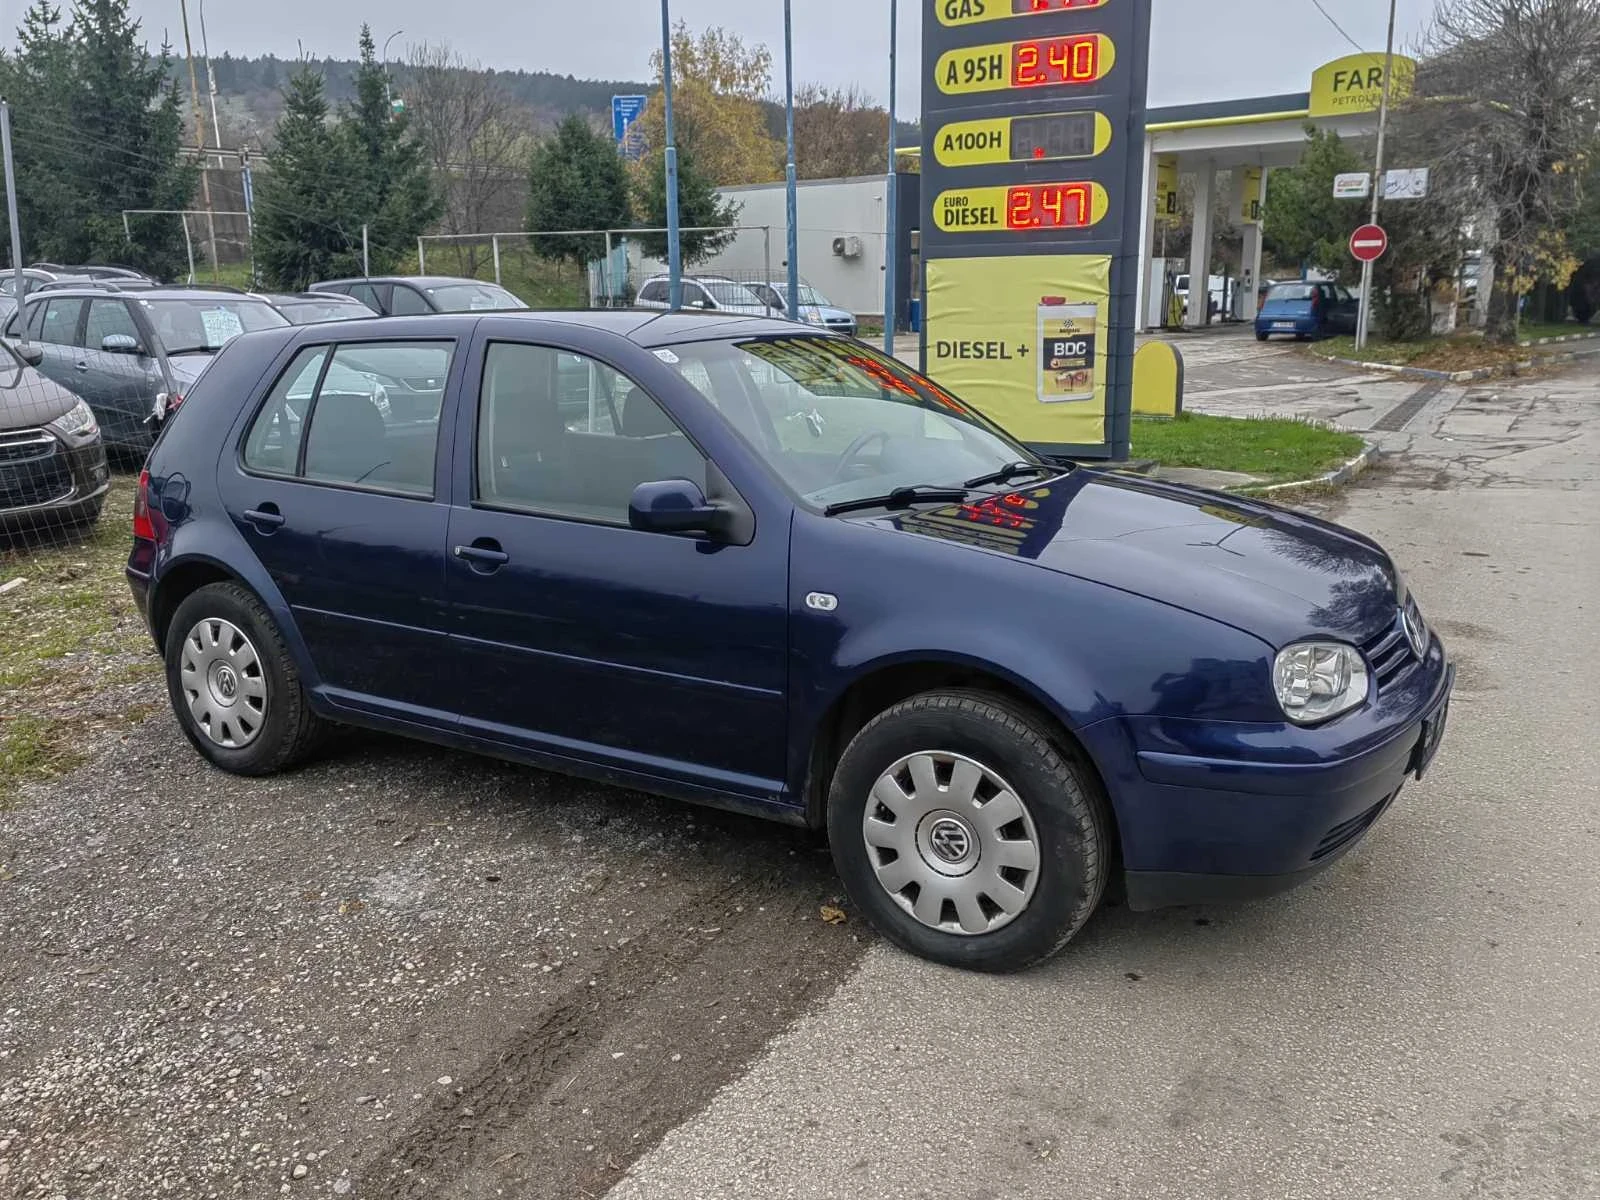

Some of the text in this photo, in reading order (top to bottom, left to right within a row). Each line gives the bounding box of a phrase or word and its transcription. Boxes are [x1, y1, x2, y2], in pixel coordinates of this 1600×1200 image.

[945, 0, 985, 20] GAS
[1018, 42, 1093, 83] 2.40
[944, 196, 969, 207] EURO
[1012, 188, 1086, 226] 2.47
[944, 207, 998, 226] DIESEL
[936, 341, 1013, 360] DIESEL
[1054, 341, 1087, 356] BDC
